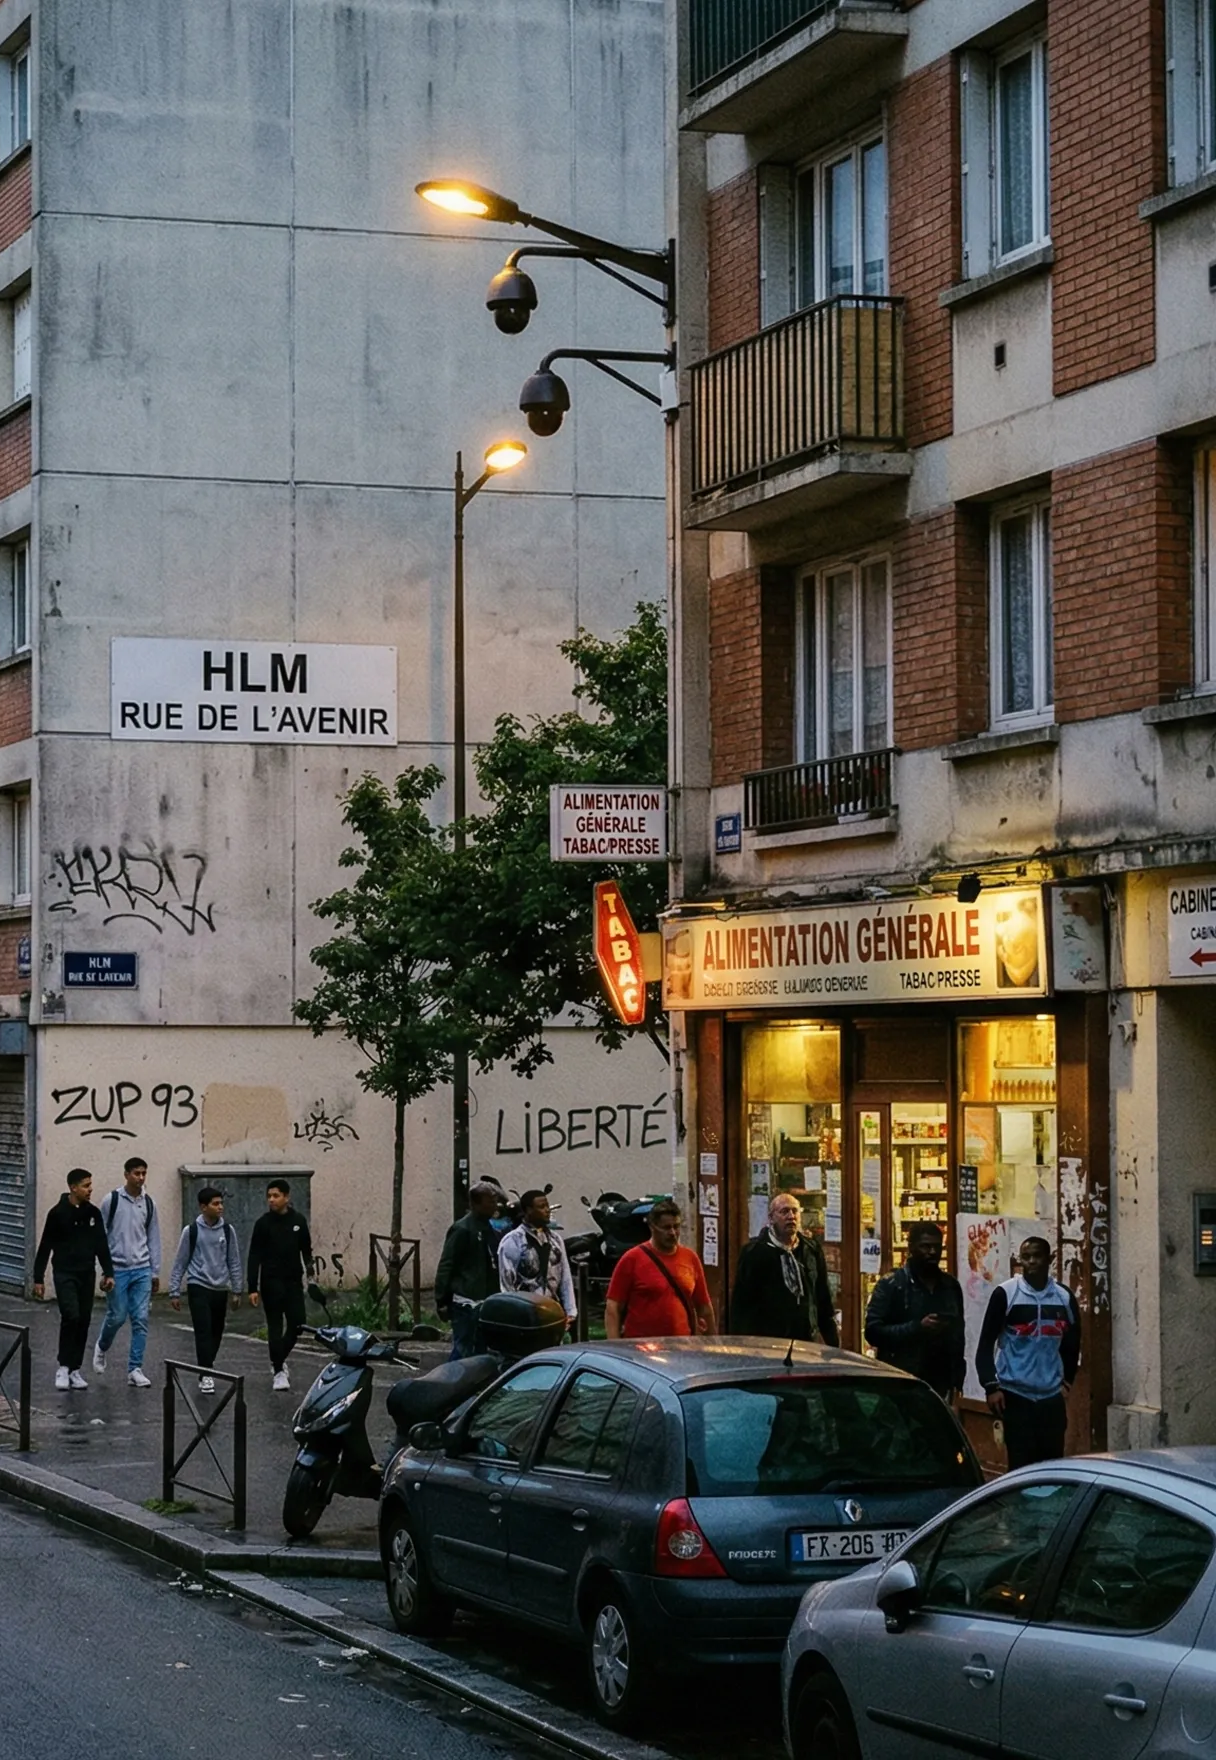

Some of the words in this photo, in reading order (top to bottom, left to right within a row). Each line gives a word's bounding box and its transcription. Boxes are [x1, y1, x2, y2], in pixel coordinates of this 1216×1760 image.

[202, 650, 308, 694] HLM
[120, 701, 184, 731] RUE
[197, 703, 239, 732] DE
[252, 705, 390, 736] L'AVENIR
[563, 793, 660, 810] ALIMENTATION
[575, 811, 647, 833] GÉNÉRALE
[602, 892, 639, 1013] TABAC
[703, 920, 850, 971] ALIMENTATION
[856, 903, 981, 964] GÉNÉRALE
[899, 971, 935, 990] TABAC
[937, 969, 981, 989] PRESSE
[50, 1081, 143, 1125] ZUP
[151, 1083, 199, 1128] 93
